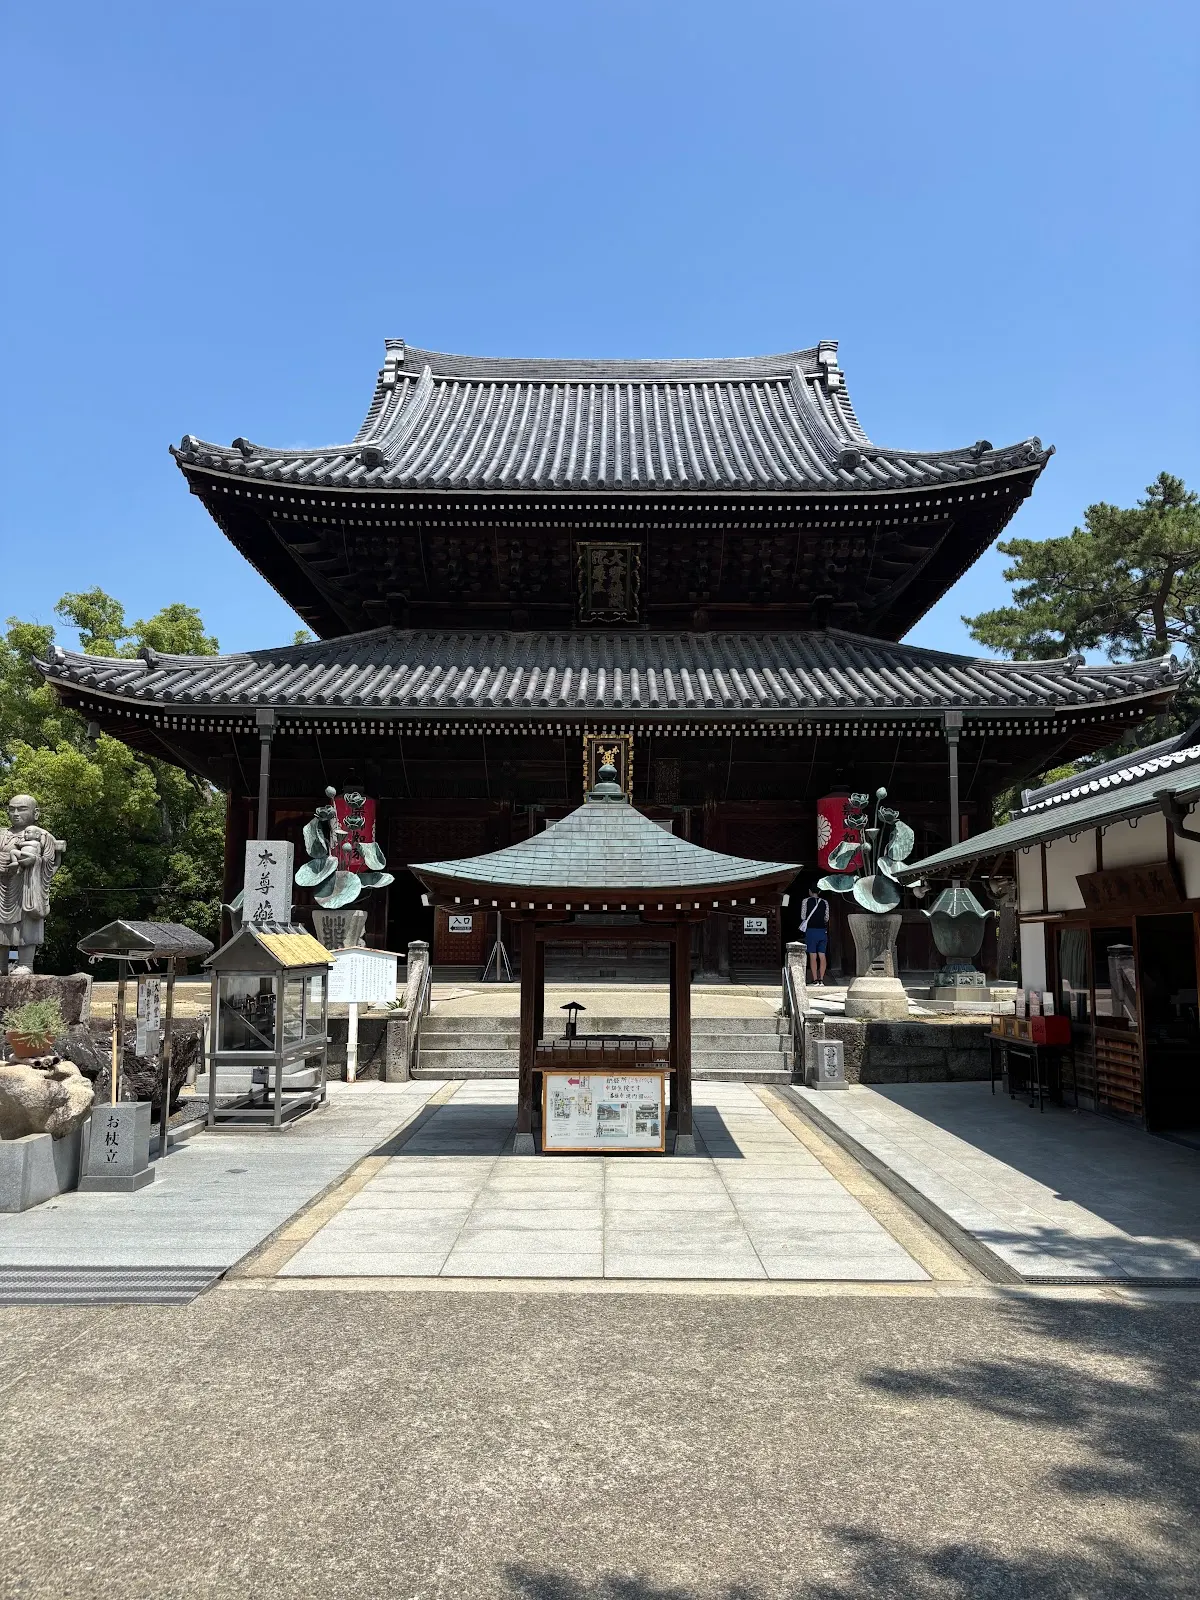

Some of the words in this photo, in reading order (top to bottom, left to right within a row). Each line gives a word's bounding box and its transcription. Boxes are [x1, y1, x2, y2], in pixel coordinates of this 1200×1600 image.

[746, 919, 763, 928] 出口
[104, 1115, 120, 1164] お杖立
